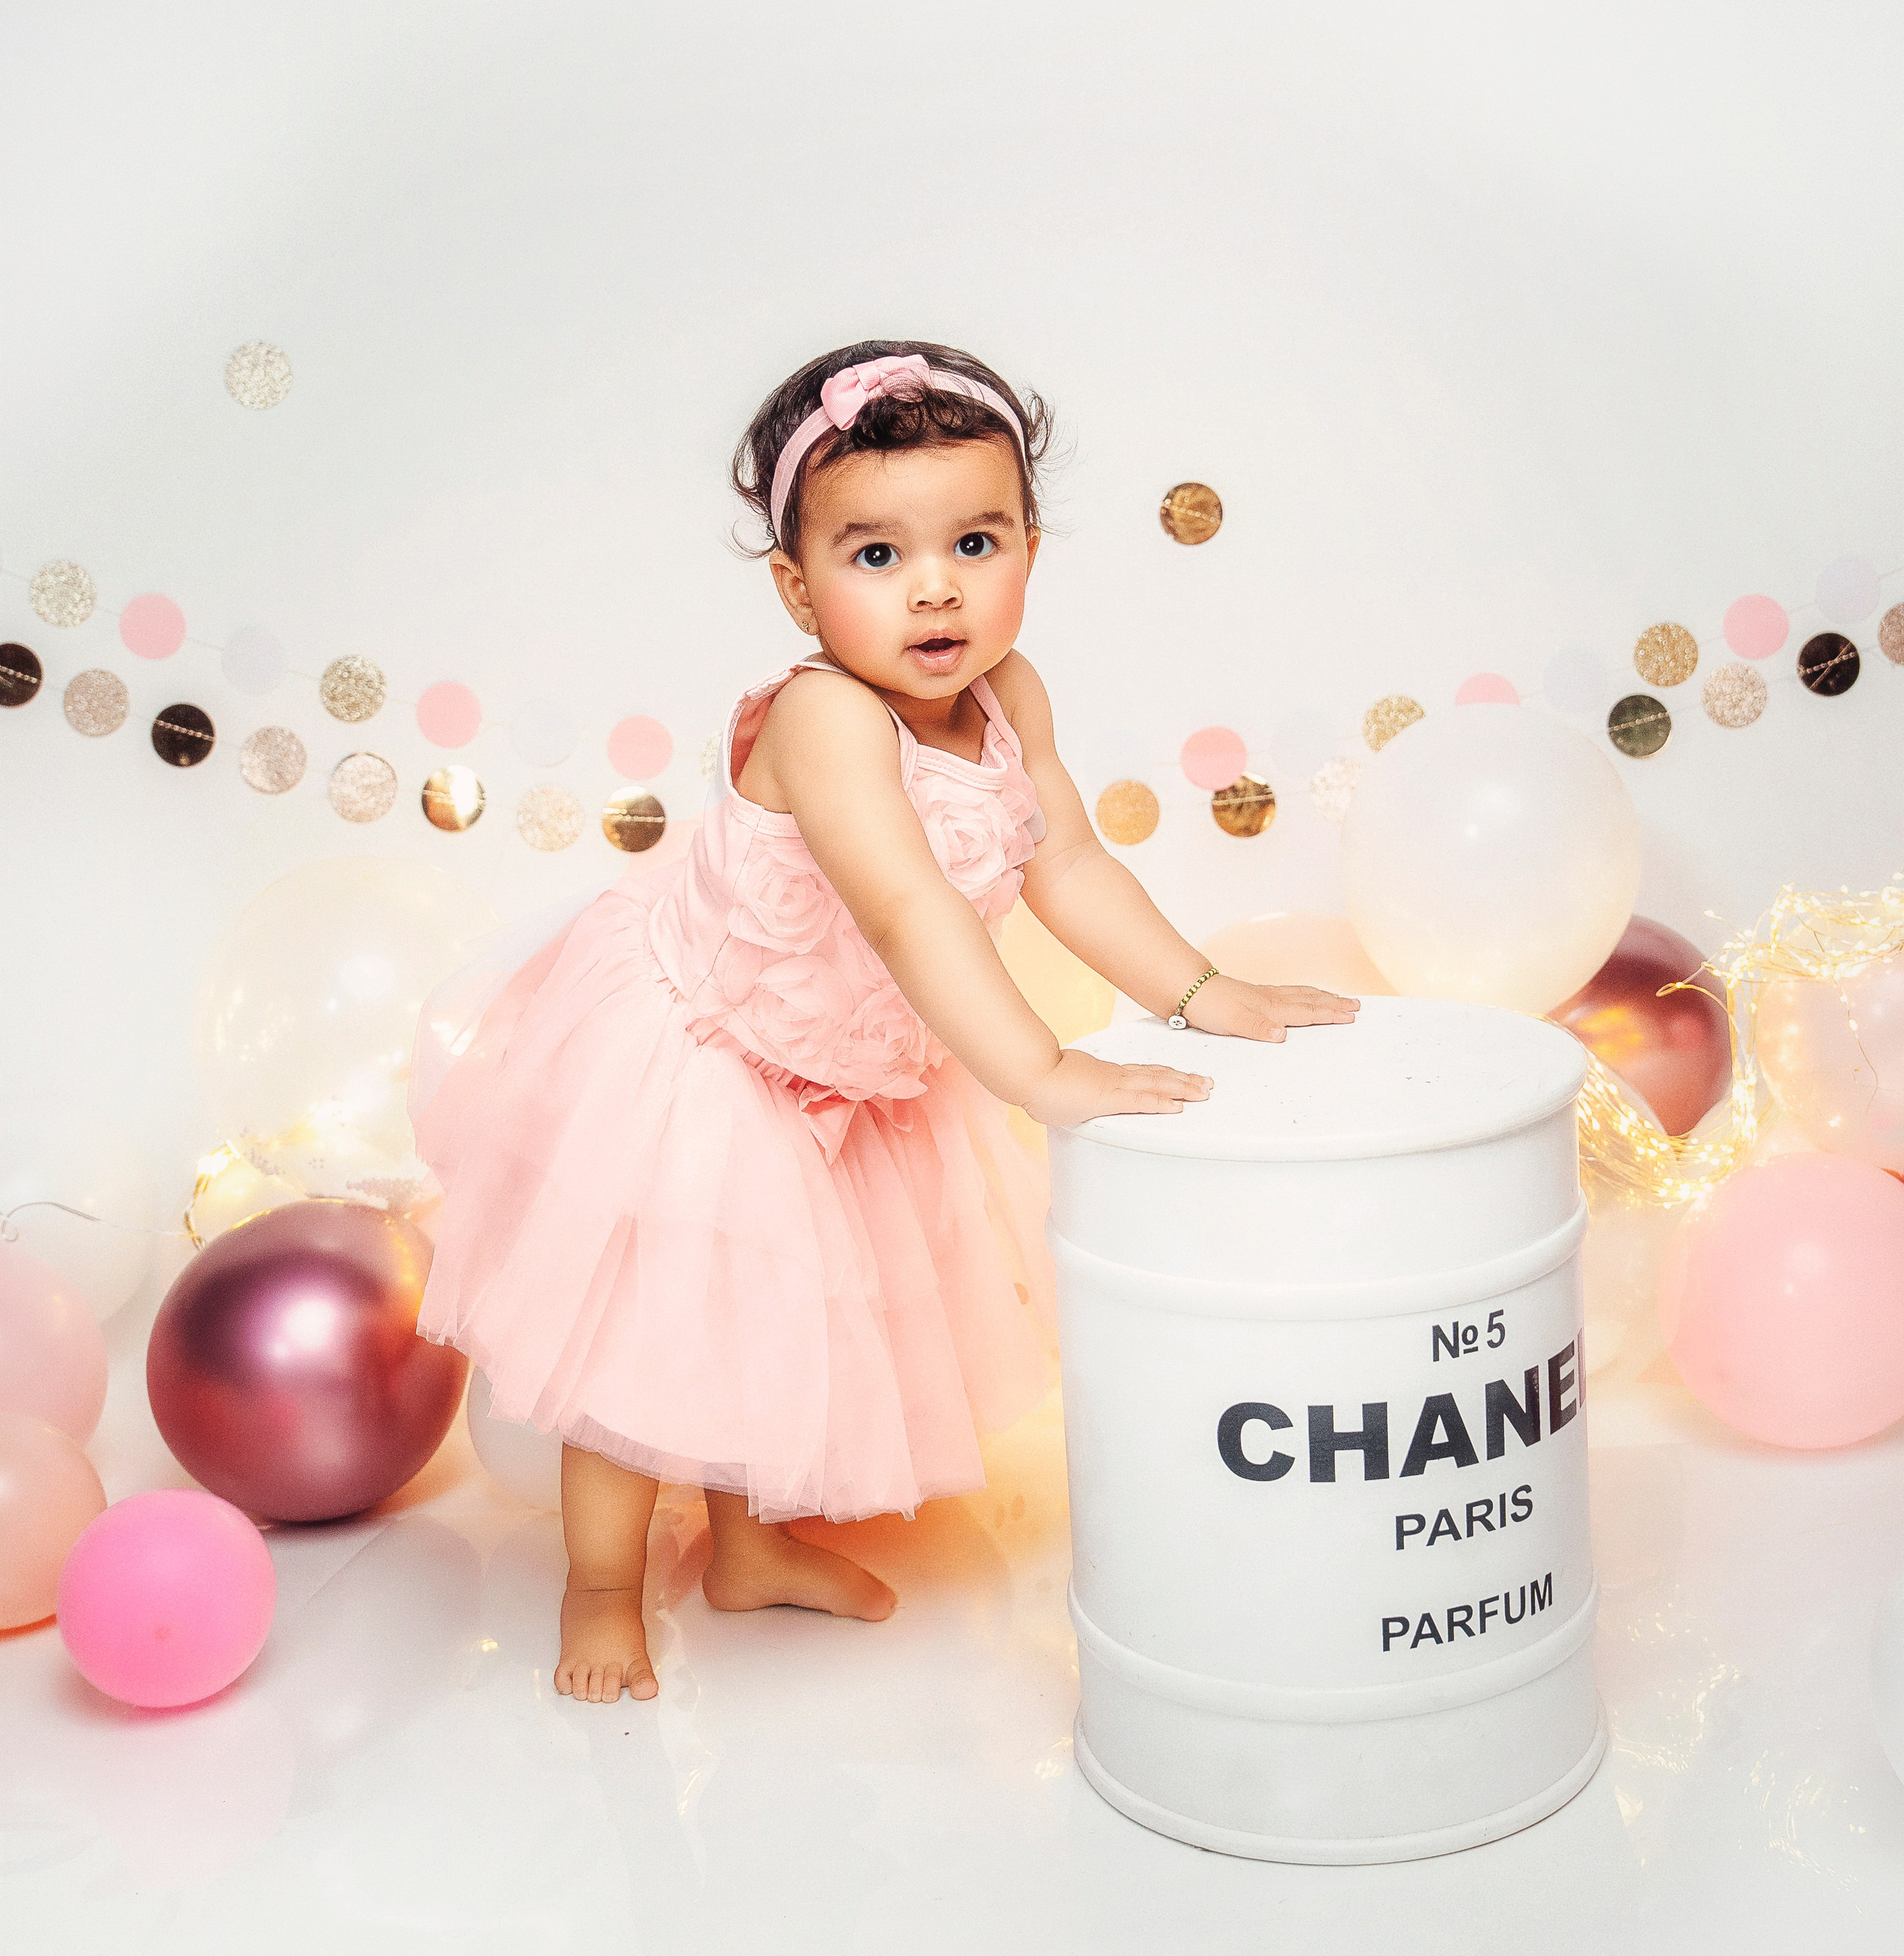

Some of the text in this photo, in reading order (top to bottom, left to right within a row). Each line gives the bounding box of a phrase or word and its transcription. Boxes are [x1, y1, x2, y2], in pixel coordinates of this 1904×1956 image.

[1487, 1309, 1505, 1348] 5
[1396, 1484, 1533, 1551] PARIS
[1382, 1572, 1553, 1652] PARFUM
